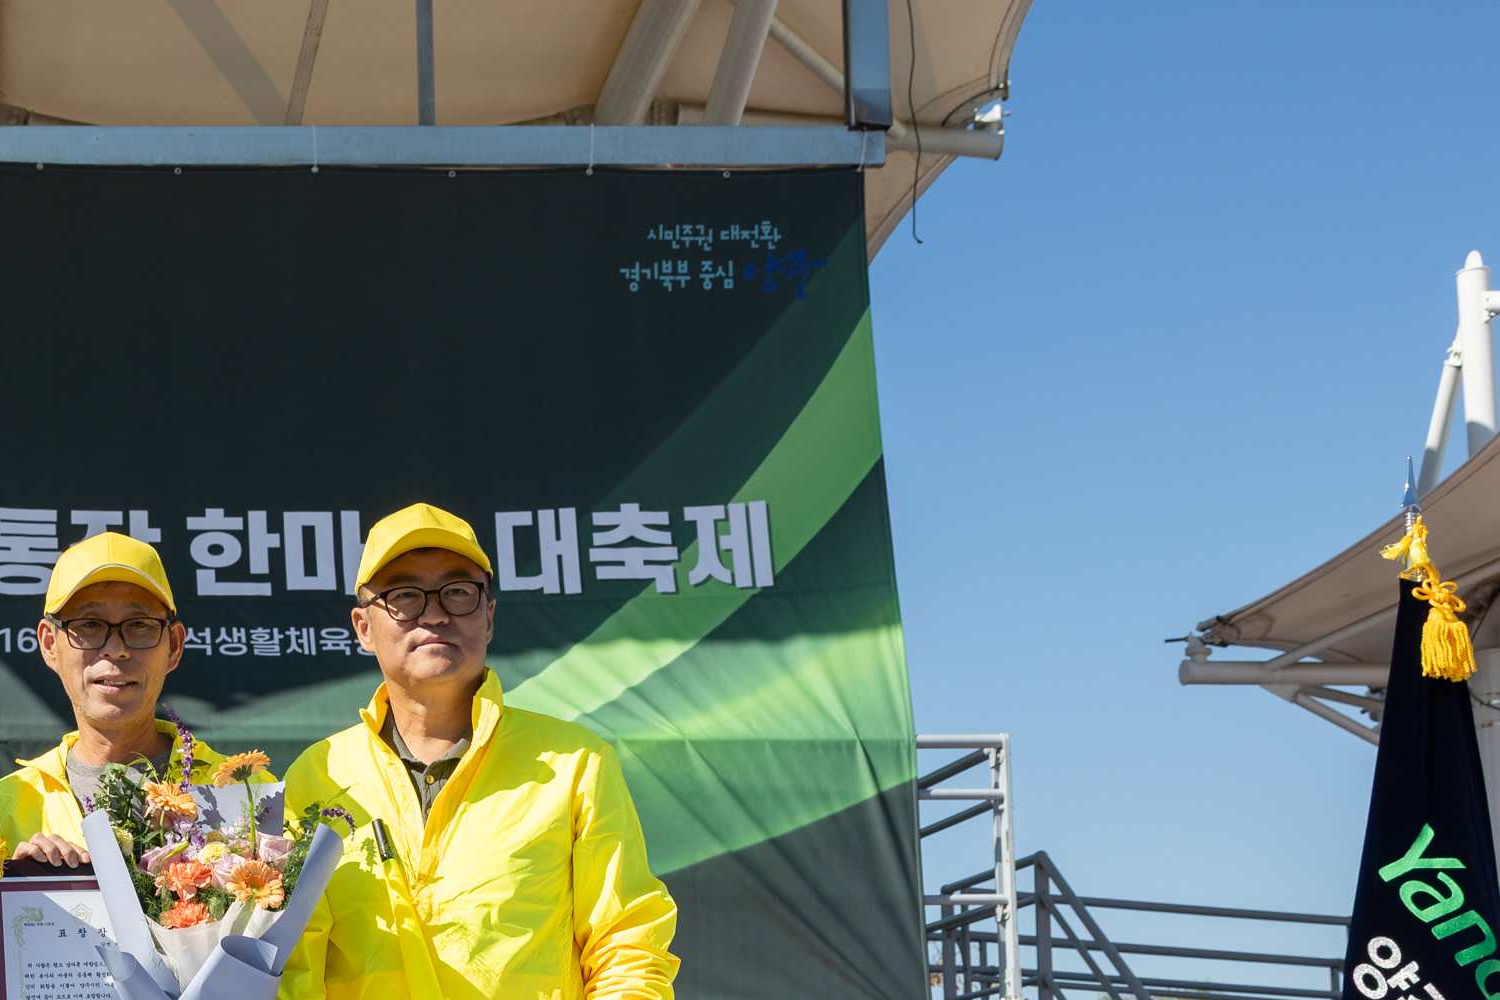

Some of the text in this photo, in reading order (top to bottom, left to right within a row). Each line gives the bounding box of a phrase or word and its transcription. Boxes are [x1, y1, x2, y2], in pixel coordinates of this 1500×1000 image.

[647, 220, 782, 251] 시민주권 대전환
[620, 249, 828, 299] 경기북부 중심 양주
[187, 508, 366, 596] 한마
[495, 500, 774, 594] 대축제
[184, 627, 375, 656] 석생활체육
